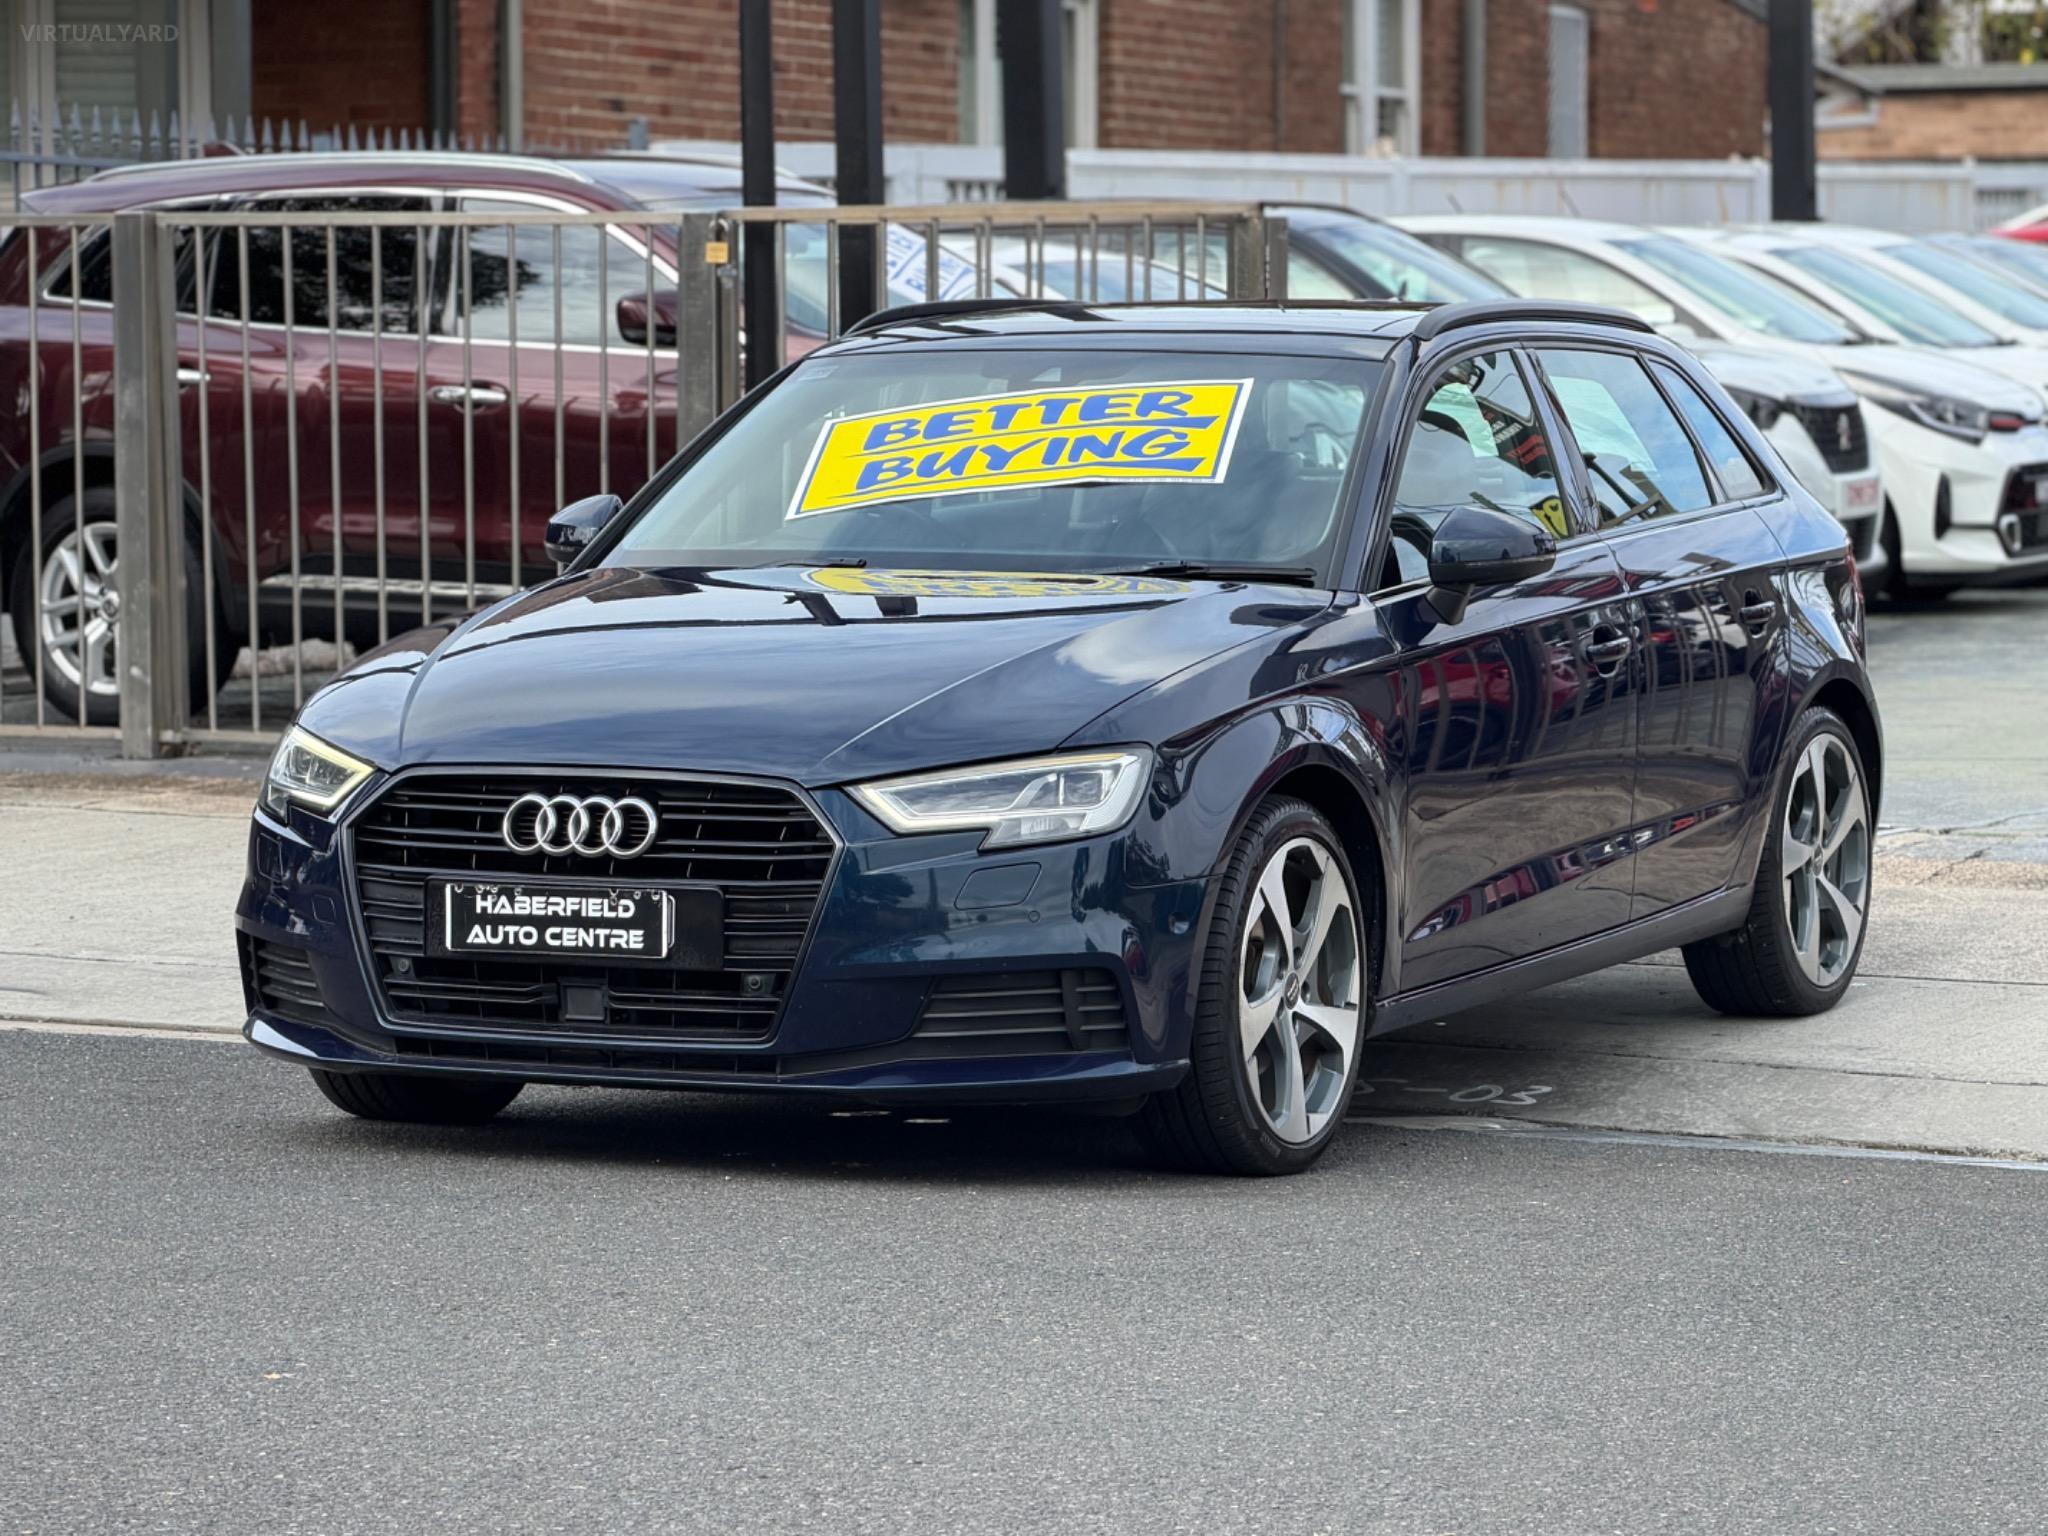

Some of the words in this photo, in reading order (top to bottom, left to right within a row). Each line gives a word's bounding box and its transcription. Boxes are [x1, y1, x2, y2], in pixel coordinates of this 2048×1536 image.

[863, 391, 1194, 451] BETTER
[856, 428, 1191, 491] BUYING
[475, 894, 636, 919] HABERFIELD
[466, 924, 538, 946] AUTO
[544, 927, 645, 949] CENTRE
